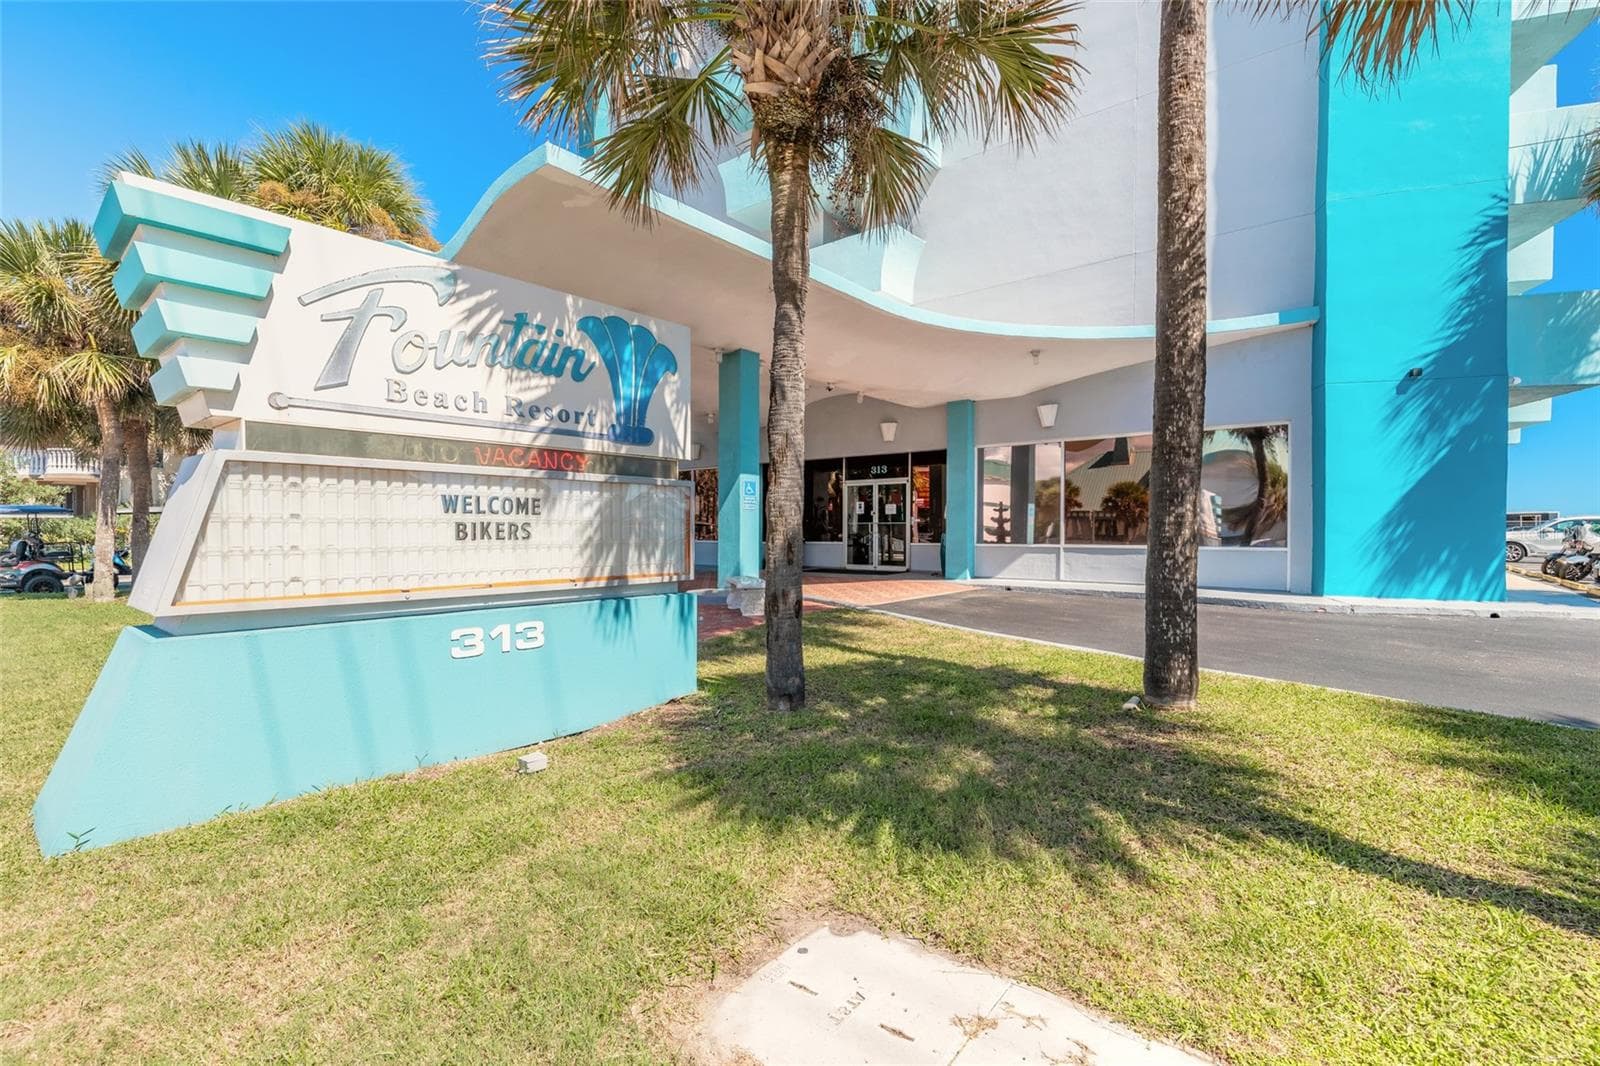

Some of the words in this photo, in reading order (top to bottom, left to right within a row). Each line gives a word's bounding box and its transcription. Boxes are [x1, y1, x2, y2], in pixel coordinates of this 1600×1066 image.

[298, 266, 596, 391] Fountain
[384, 378, 489, 413] Beach
[505, 398, 596, 427] Resort
[475, 447, 591, 470] VACANCY
[871, 465, 888, 474] 313
[441, 494, 541, 516] WELCOME
[455, 521, 532, 541] BIKERS
[450, 620, 545, 659] 313
